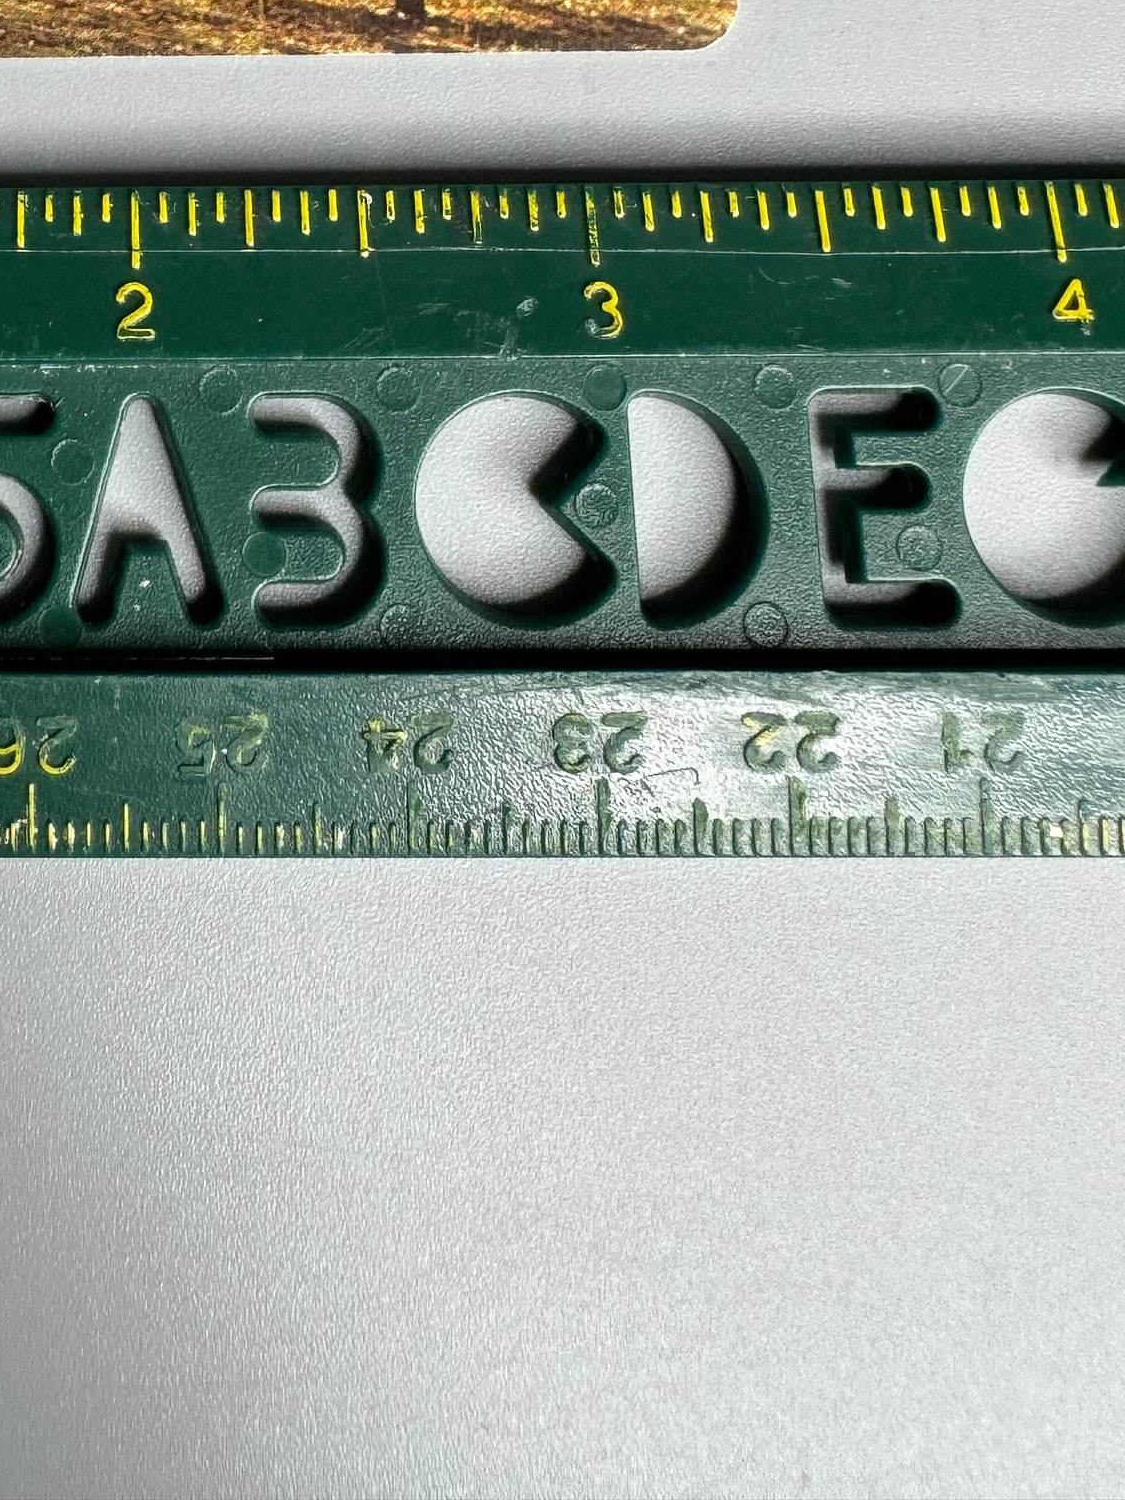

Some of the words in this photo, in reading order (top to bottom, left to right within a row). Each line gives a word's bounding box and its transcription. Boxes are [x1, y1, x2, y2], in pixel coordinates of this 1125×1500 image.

[115, 283, 156, 341] 2
[582, 280, 624, 339] 3
[1051, 277, 1095, 330] 4
[175, 712, 270, 779] 25
[361, 712, 454, 775] 24
[552, 710, 648, 775] 23
[741, 709, 841, 774] 22
